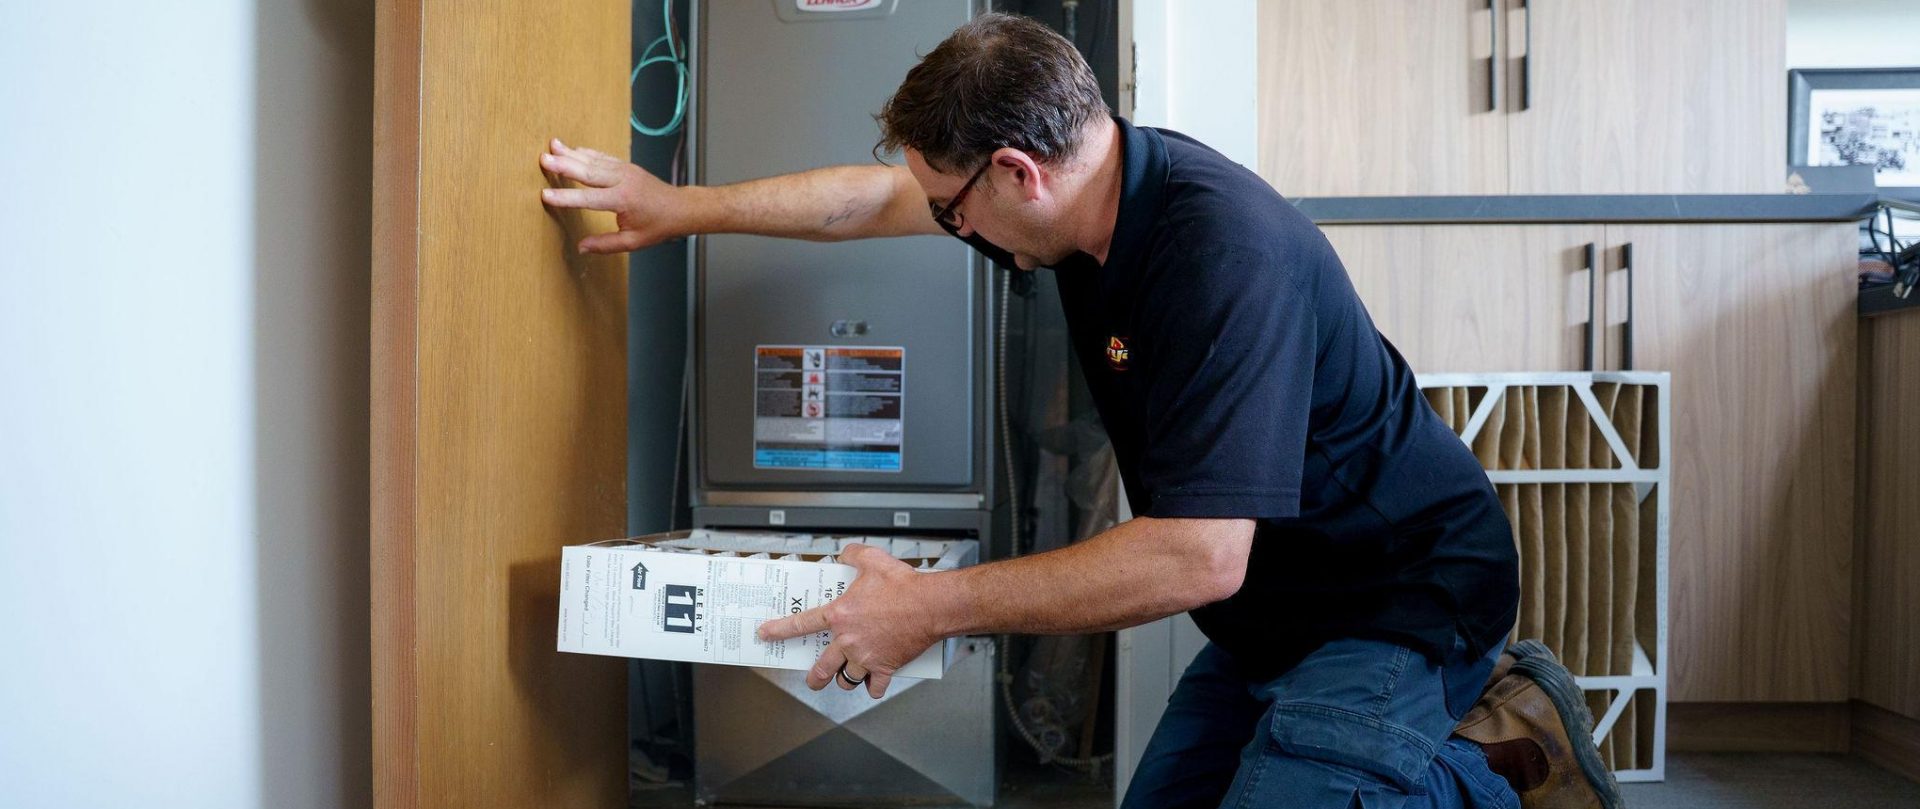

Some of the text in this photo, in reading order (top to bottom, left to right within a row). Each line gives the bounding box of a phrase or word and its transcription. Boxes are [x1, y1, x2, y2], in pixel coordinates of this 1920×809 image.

[583, 585, 591, 611] Changed
[666, 591, 694, 627] 11
[695, 588, 704, 632] MERV
